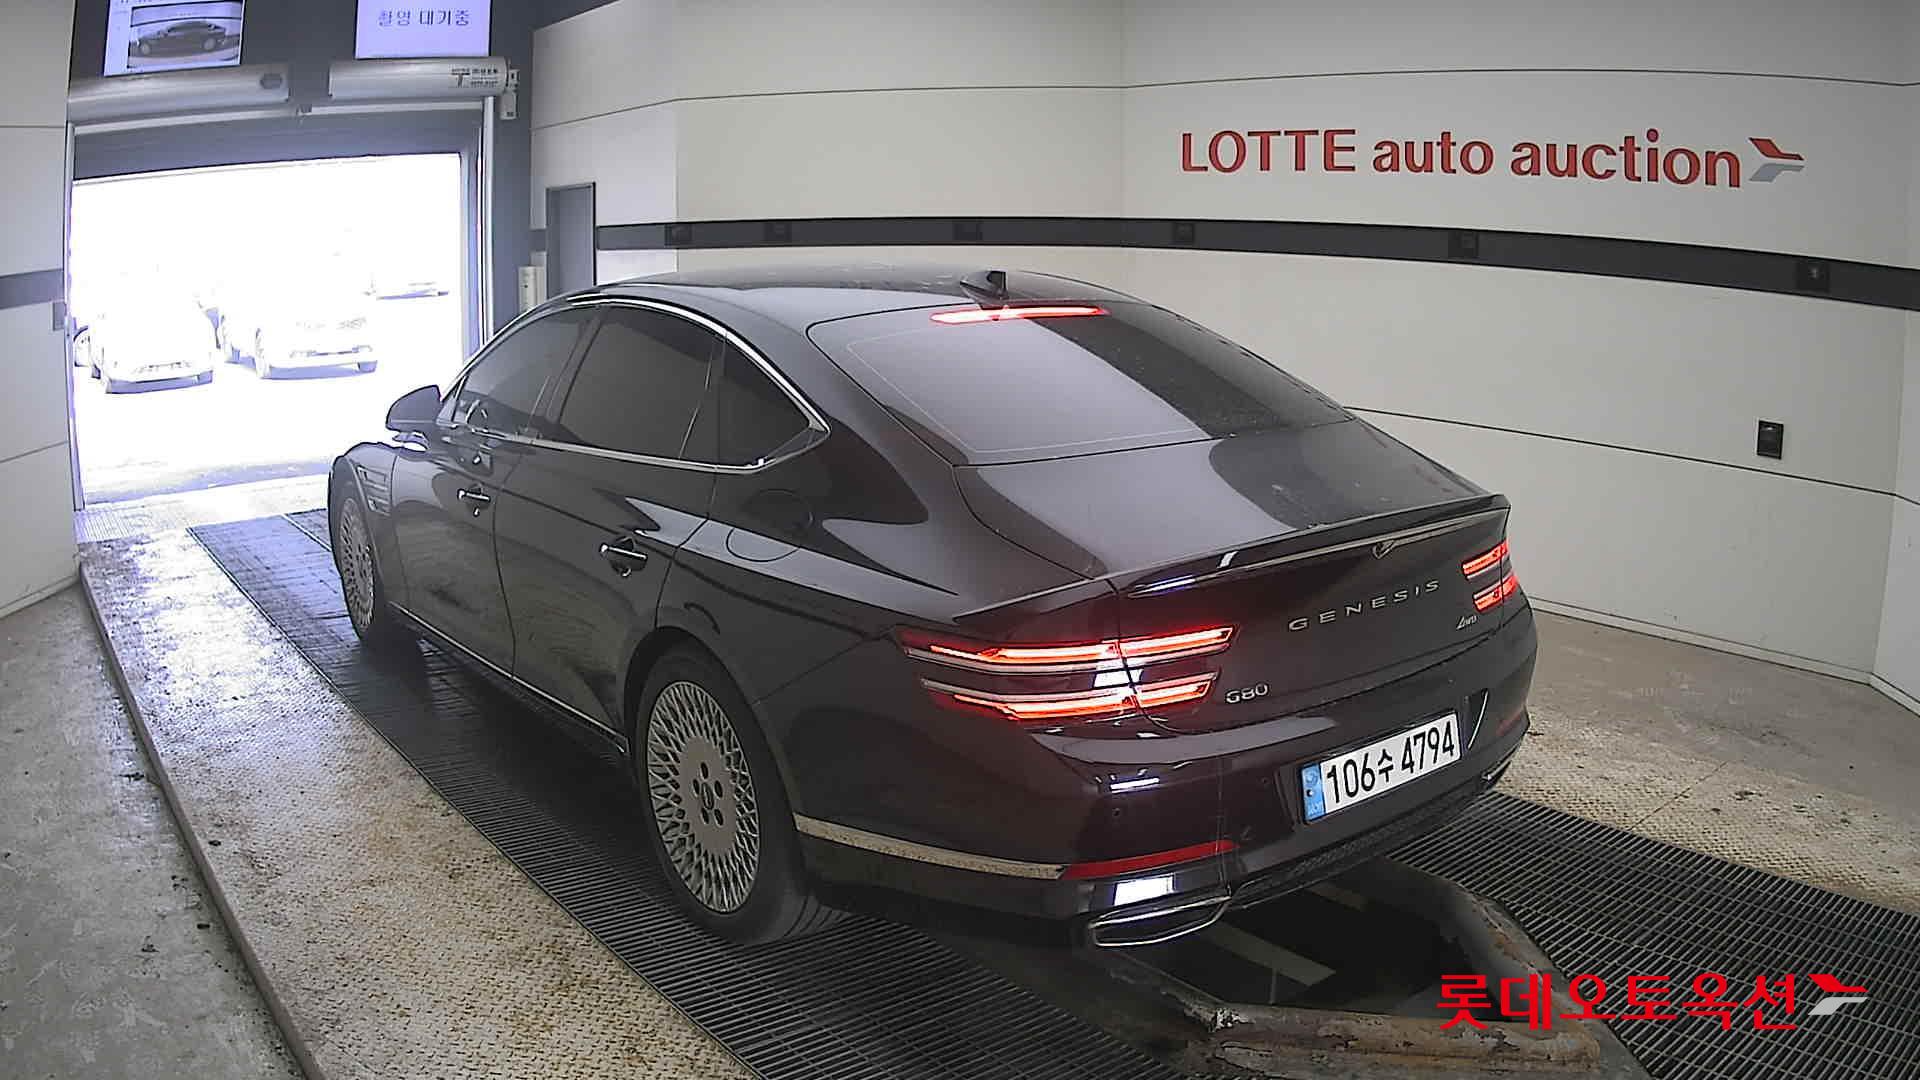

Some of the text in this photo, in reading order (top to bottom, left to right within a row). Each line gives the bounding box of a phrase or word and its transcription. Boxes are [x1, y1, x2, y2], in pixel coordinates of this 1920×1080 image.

[420, 10, 469, 26] 대기중
[1182, 128, 1742, 188] LOTTE auto auction
[1288, 579, 1440, 631] GENESIS
[1225, 683, 1269, 703] G80
[1326, 720, 1455, 804] 106수 4794
